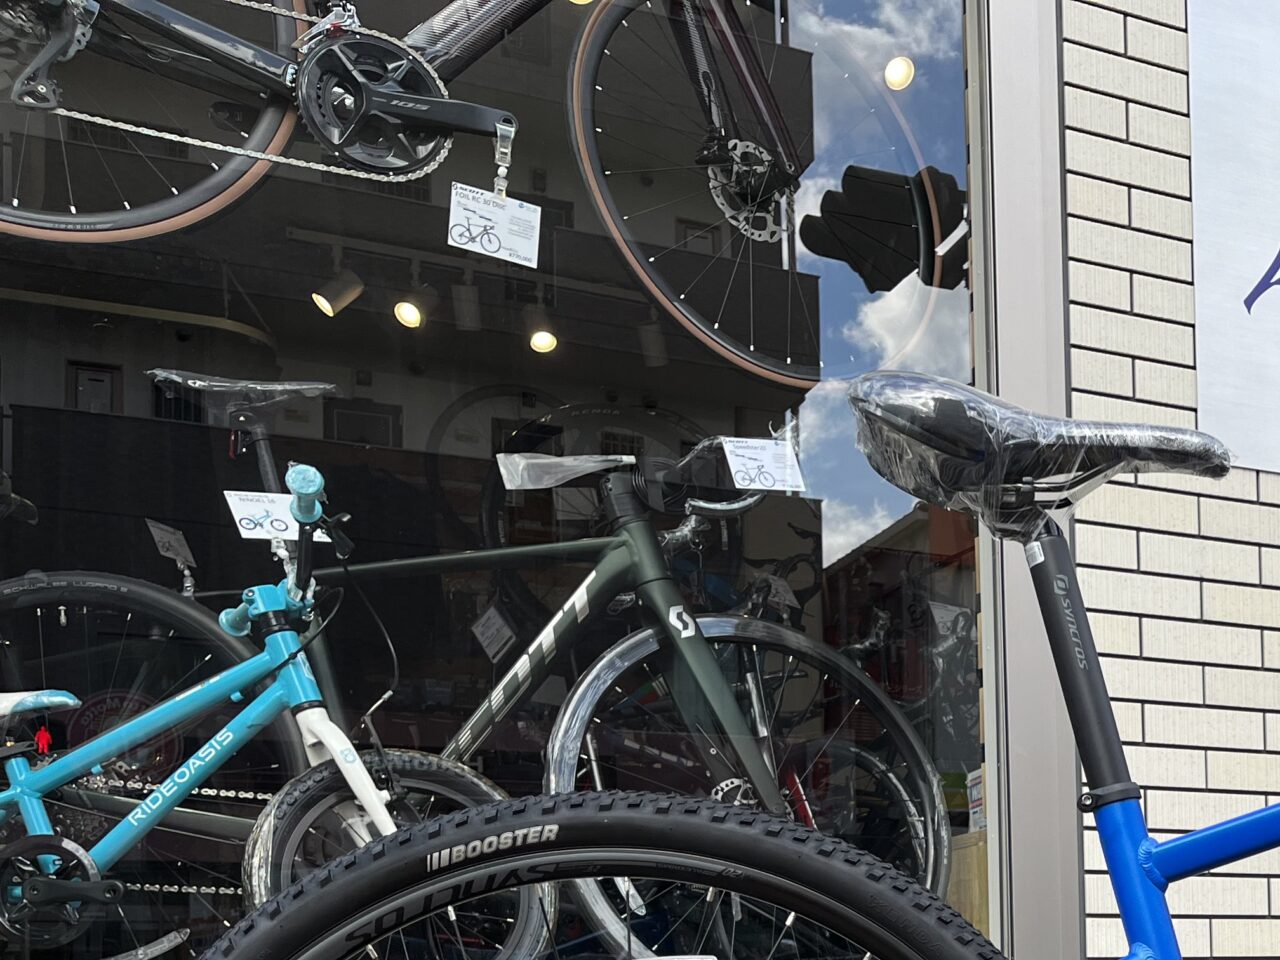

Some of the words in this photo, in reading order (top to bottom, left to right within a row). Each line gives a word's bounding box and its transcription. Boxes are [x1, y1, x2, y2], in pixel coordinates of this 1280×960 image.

[390, 100, 431, 110] 105
[455, 191, 470, 200] FOIL
[3, 581, 68, 596] SCHWALBE
[72, 580, 118, 591] LUGANO
[438, 569, 598, 763] COTT
[127, 727, 234, 826] RIDEOASIS
[451, 824, 559, 863] BOOSTER
